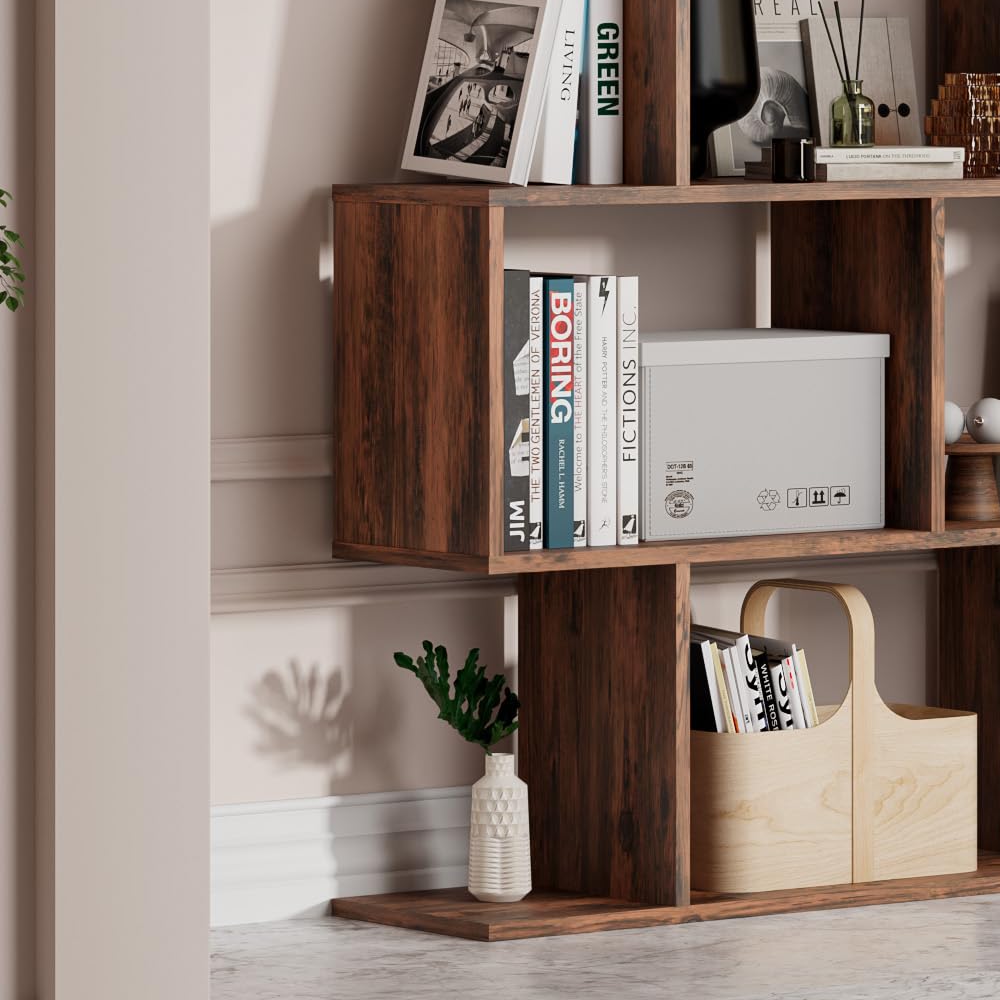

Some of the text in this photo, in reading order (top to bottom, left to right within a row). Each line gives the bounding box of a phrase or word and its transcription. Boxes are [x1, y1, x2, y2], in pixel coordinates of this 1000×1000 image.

[560, 29, 576, 101] LIVING
[597, 22, 620, 116] GREEN
[550, 291, 572, 424] BORING
[574, 291, 583, 443] to THE HEART of the Free State
[600, 336, 608, 359] HARRY
[600, 361, 608, 389] POTTER
[529, 289, 541, 503] THE TWO GENTLEMEN OF VERONA
[600, 390, 608, 406] AND
[622, 306, 637, 462] FICTIONS INC.
[558, 439, 566, 509] RACHEL HAMM
[509, 499, 526, 543] JIM
[760, 664, 773, 701] WHITE
